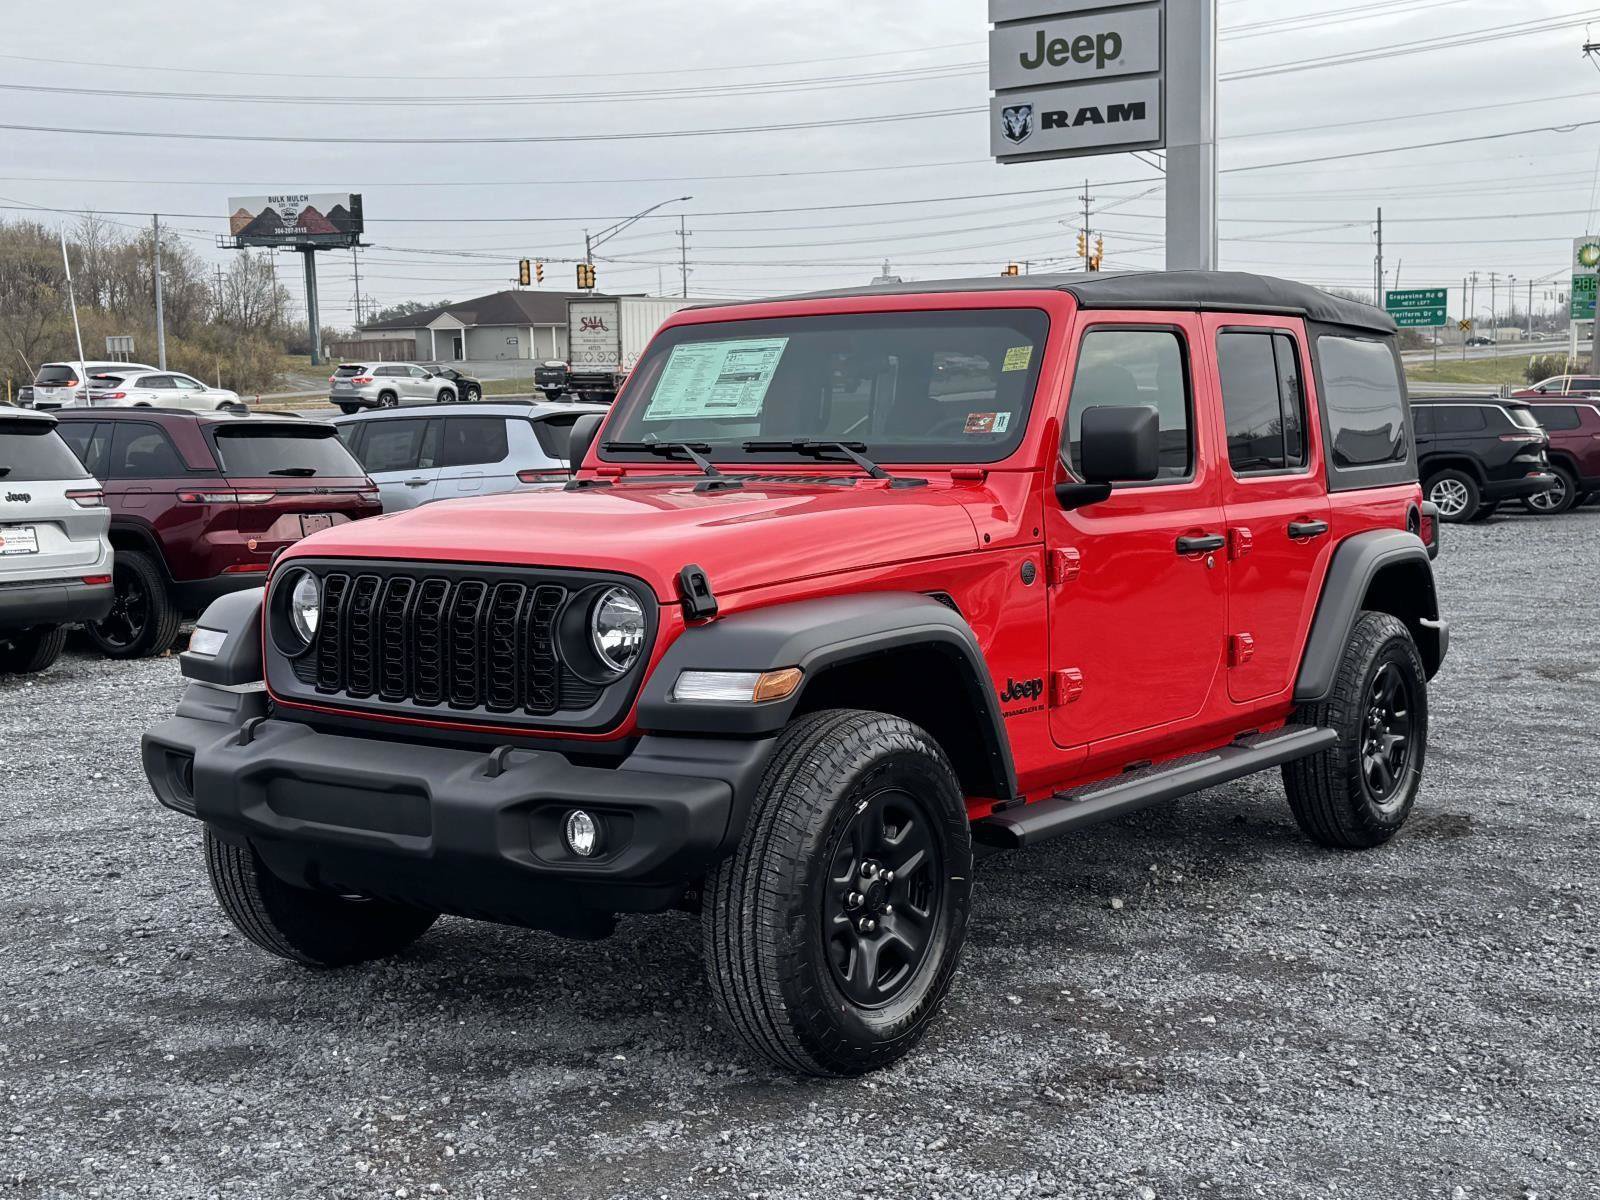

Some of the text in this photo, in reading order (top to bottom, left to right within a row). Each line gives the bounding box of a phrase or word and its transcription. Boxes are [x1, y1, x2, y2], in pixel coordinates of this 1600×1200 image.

[1020, 30, 1122, 70] Jeep
[1041, 101, 1146, 130] RAM
[287, 194, 308, 202] MULCH
[580, 315, 609, 332] SAIA
[5, 491, 32, 504] Jeep
[1001, 678, 1043, 702] Jeep
